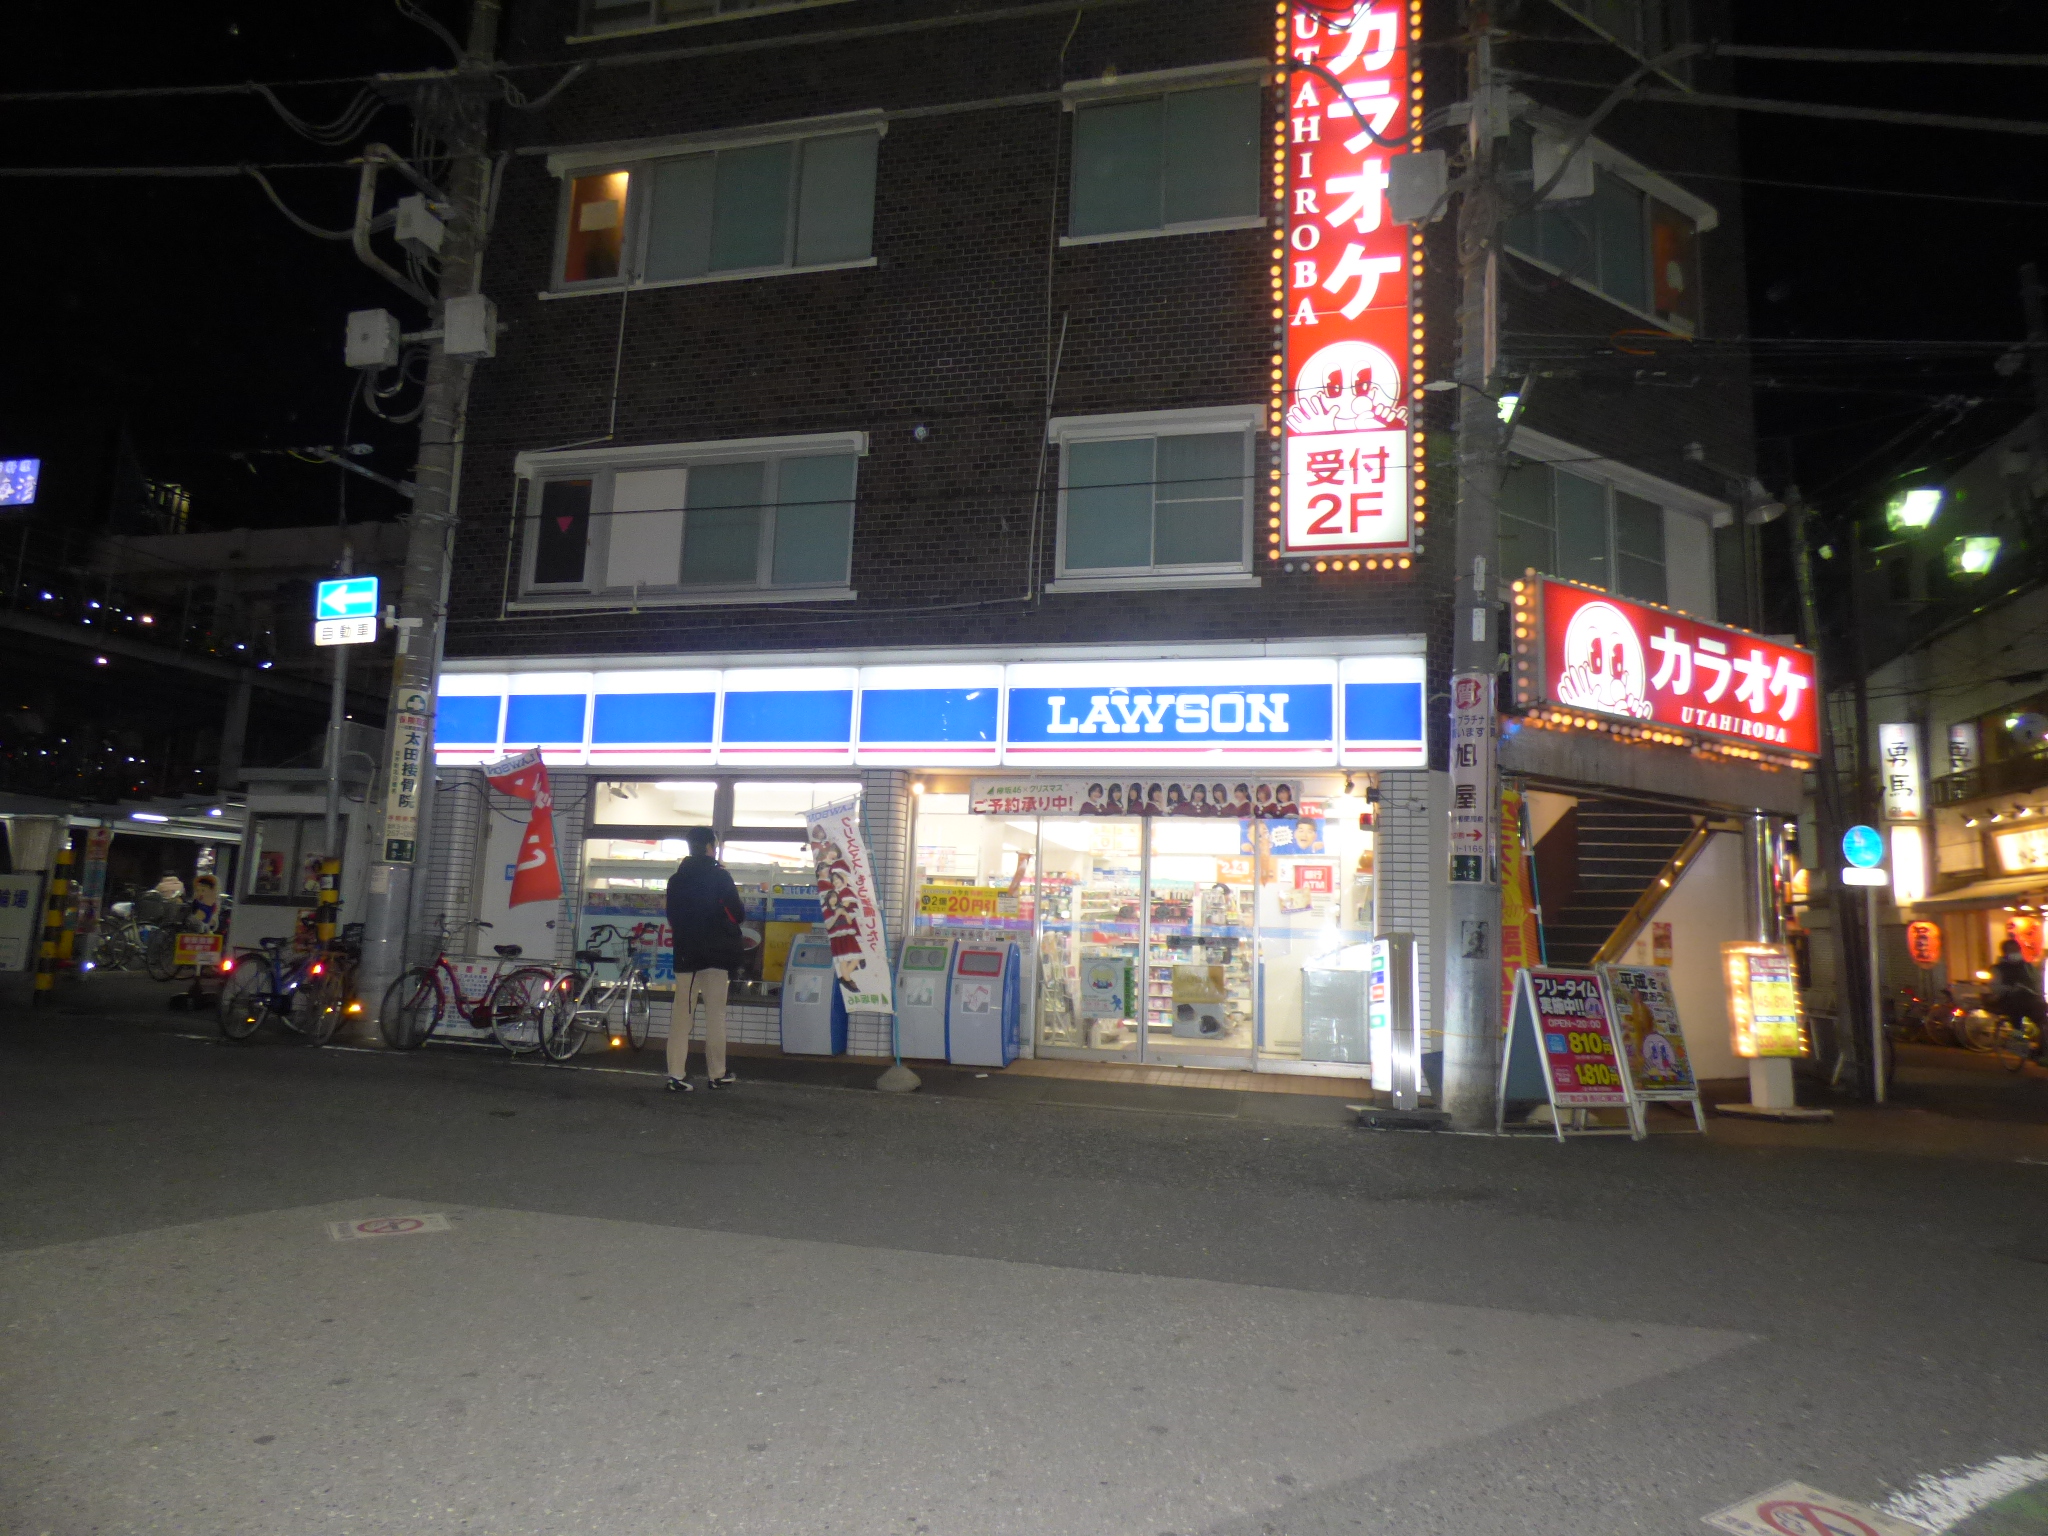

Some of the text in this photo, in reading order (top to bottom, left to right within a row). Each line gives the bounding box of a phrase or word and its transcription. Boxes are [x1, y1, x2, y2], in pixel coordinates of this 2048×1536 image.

[1291, 14, 1320, 326] UTAHIROBA
[1322, 2, 1401, 320] カラオケ
[1306, 446, 1390, 487] 受付
[1306, 491, 1384, 536] 2F
[1650, 626, 1808, 722] カラオケ
[1047, 693, 1289, 733] LAWSON
[1682, 706, 1787, 744] UTAHIROBA
[1303, 880, 1325, 889] ATM
[1534, 978, 1600, 998] フリータイム
